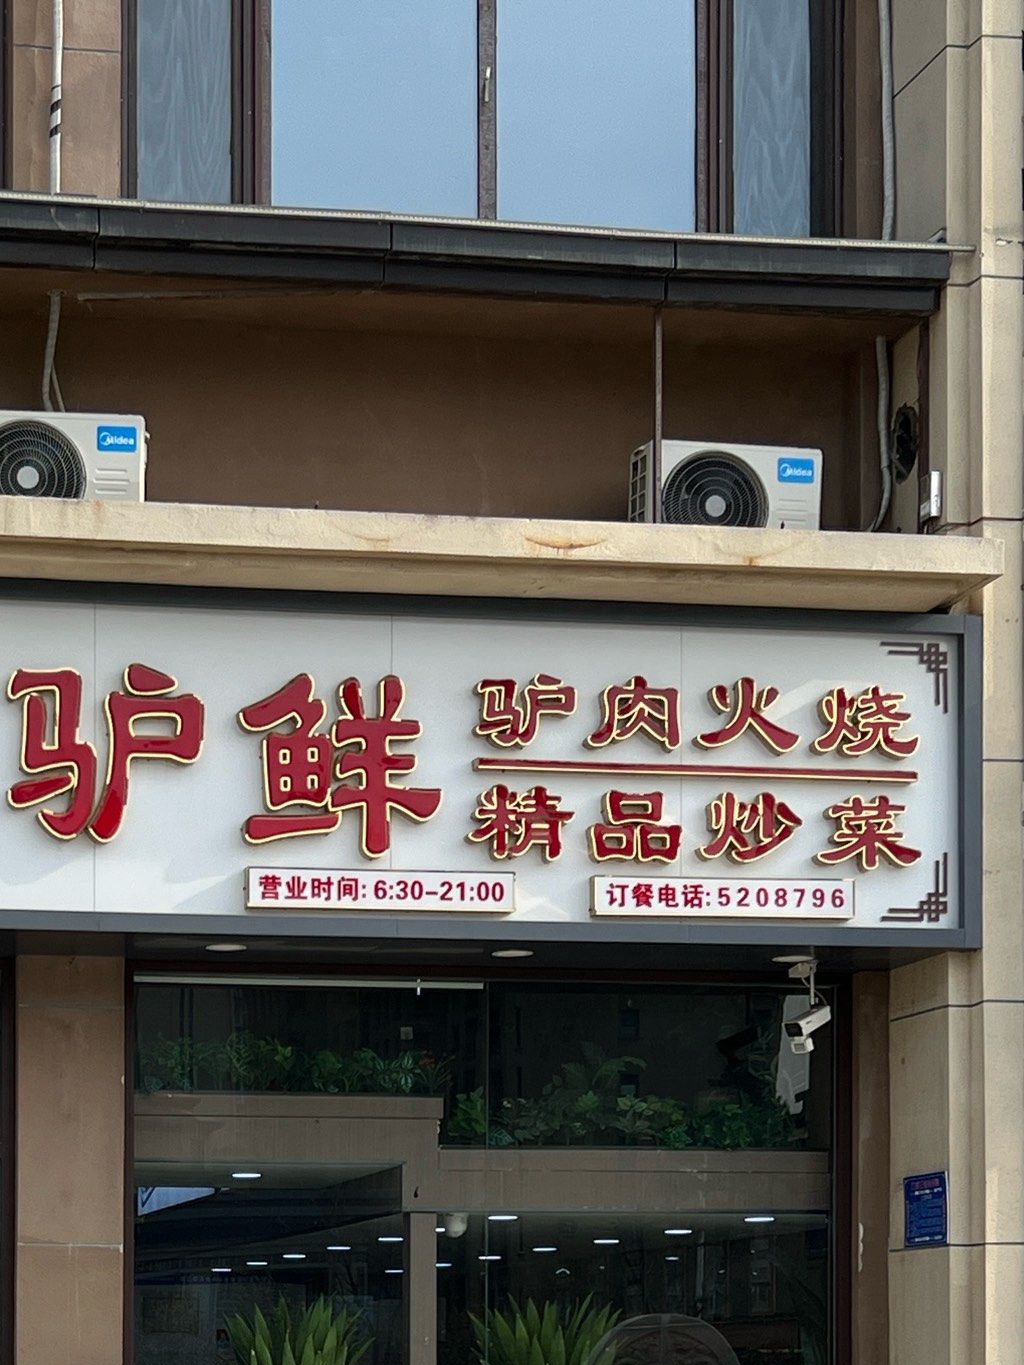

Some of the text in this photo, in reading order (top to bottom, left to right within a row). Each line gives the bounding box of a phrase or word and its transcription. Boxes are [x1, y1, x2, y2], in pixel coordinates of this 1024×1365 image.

[101, 433, 134, 446] Midea
[781, 465, 812, 477] Midea
[473, 674, 921, 757] 驴肉火烧
[468, 784, 922, 870] 精品炒菜
